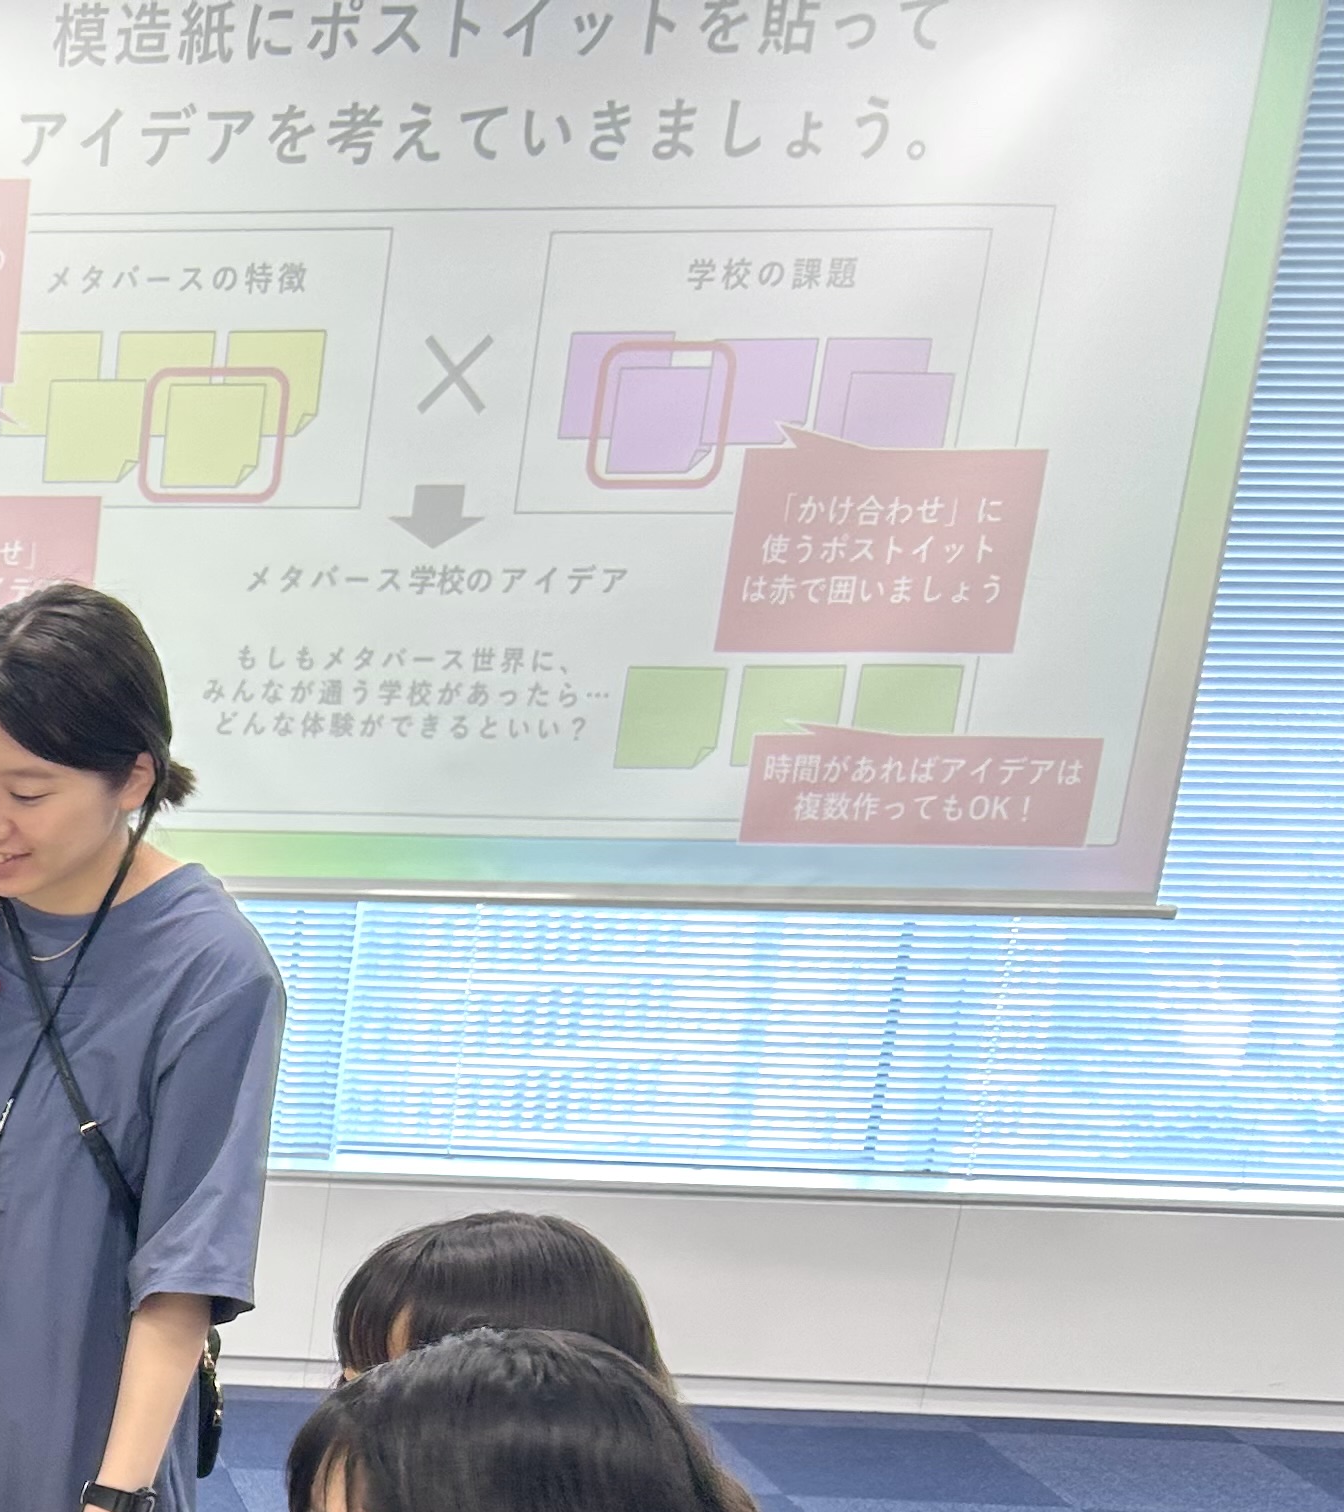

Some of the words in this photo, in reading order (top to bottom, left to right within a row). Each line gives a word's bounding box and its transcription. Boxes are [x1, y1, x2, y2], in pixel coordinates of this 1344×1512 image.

[51, 0, 949, 67] 模造紙にポストイットを貼って
[19, 95, 927, 168] アイデアを考えていきましょう。
[47, 261, 308, 295] メタバースの特徴
[686, 256, 859, 291] 学校の課題
[761, 533, 994, 565] 使うポストイット
[245, 563, 629, 596] メタバース学校のアイデア
[741, 575, 1002, 606] は赤で囲いましょう
[236, 644, 572, 675] もしもメタバース世界に、
[201, 678, 610, 707] みんなが通う学校があったら…
[214, 711, 588, 741] どんな体験ができるといい？
[762, 753, 1084, 786] 時間があればアイデアは
[793, 792, 1032, 823] 複数作ってもOK！
